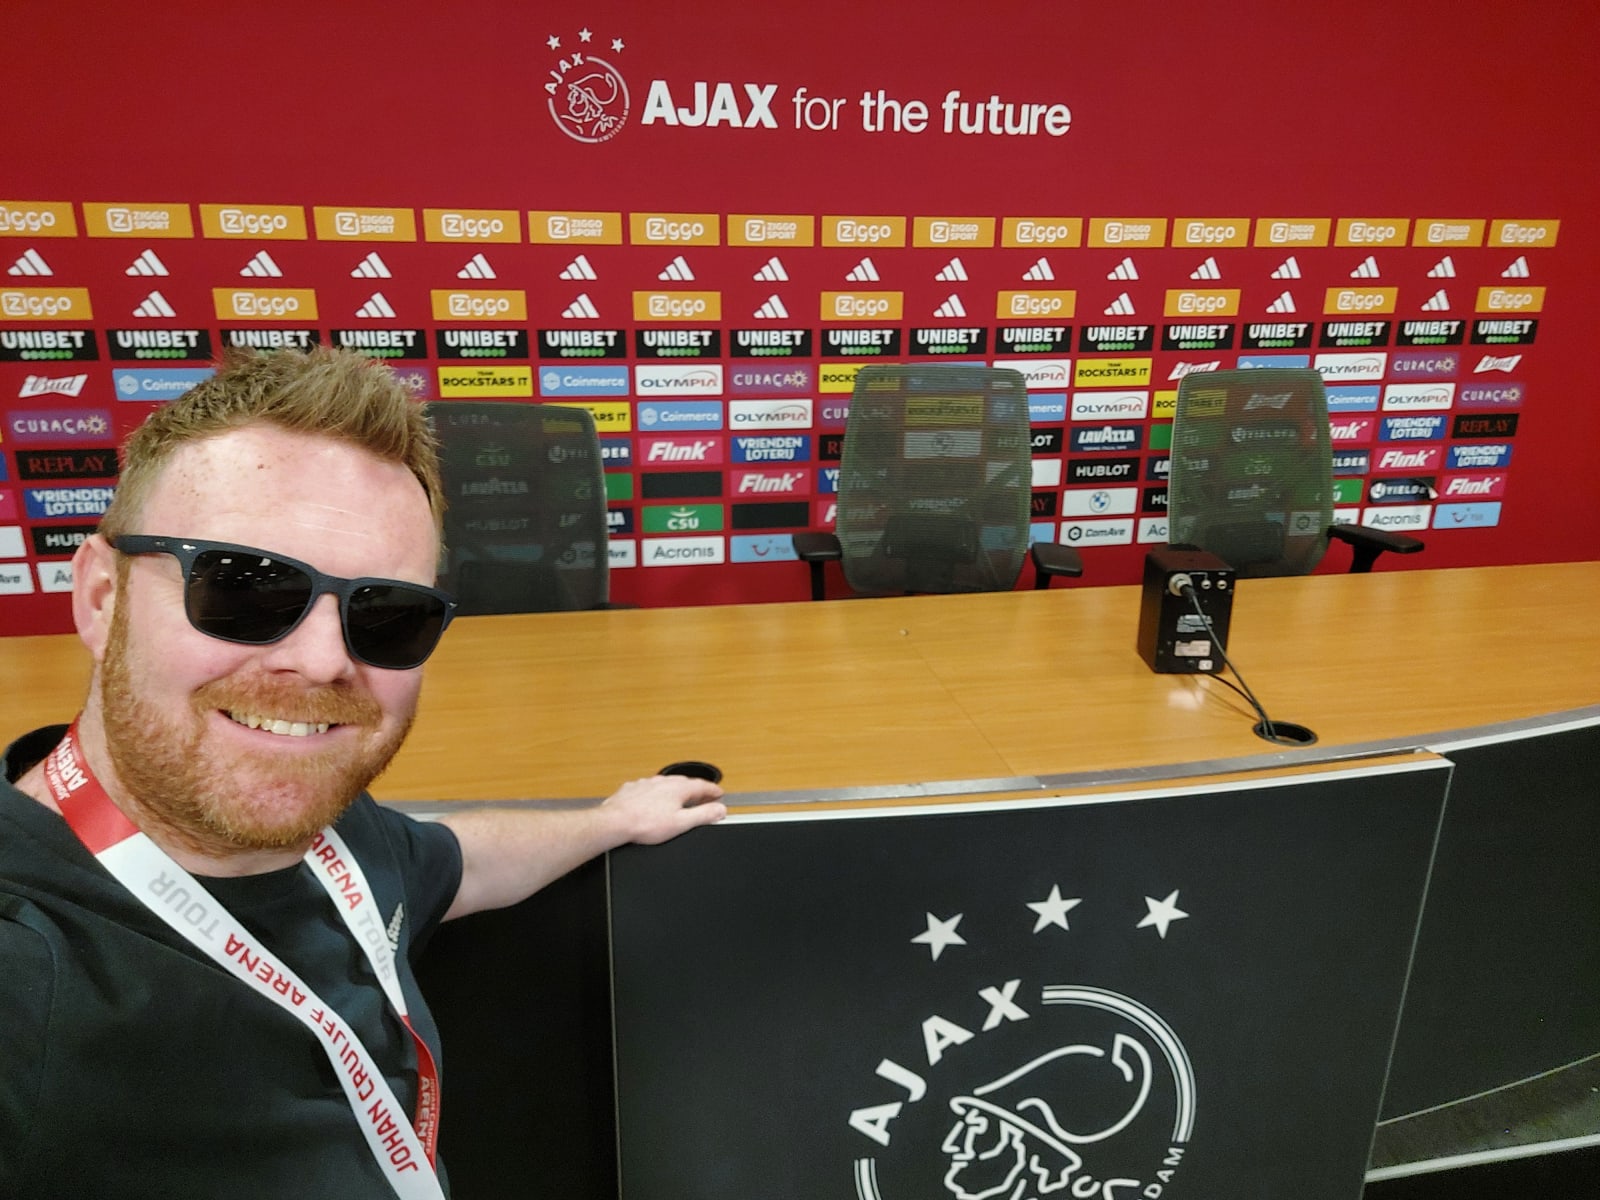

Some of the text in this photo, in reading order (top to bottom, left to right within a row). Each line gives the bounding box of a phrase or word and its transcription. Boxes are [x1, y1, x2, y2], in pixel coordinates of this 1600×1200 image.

[544, 52, 584, 95] AJAX
[641, 80, 1072, 136] AJAX for the future
[134, 211, 168, 220] ZIGGO
[133, 221, 170, 230] SPORT
[361, 225, 394, 234] SPORT
[571, 228, 602, 237] SPORT
[767, 231, 796, 239] SPORT
[1087, 326, 1148, 341] UNIBET
[1169, 326, 1228, 340] UNIBET
[1249, 324, 1307, 338] UNIBET
[1327, 322, 1385, 336] UNIBET
[1404, 322, 1460, 336] UNIBET
[1478, 321, 1532, 334] UNIBET
[0, 331, 85, 348] UNIBET
[117, 331, 199, 348] UNIBET
[230, 330, 310, 348] UNIBET
[340, 331, 416, 347] UNIBET
[444, 330, 518, 346] UNIBET
[546, 330, 618, 346] UNIBET
[643, 331, 712, 346] UNIBET
[737, 330, 804, 346] UNIBET
[829, 330, 894, 345] UNIBET
[917, 329, 980, 344] UNIBET
[1003, 328, 1065, 342] UNIBET
[1078, 368, 1148, 377] ROCKSTARS IT
[1318, 364, 1380, 374] OLYMPIA
[443, 378, 528, 386] ROCKSTARS IT
[563, 376, 625, 388] Coinmerce
[641, 376, 718, 388] OLYMPIA
[734, 370, 808, 388] CURAÇAO
[822, 374, 857, 382] ROCKS
[1024, 372, 1065, 380] MPIA
[29, 376, 76, 392] Bud
[142, 379, 196, 390] Coinme
[1327, 395, 1376, 404] Coinmerce
[1387, 394, 1449, 404] OLYMPIA
[1030, 404, 1062, 412] merce
[1076, 404, 1142, 413] OLYMPIA
[617, 413, 628, 421] IT
[660, 412, 720, 422] Coinmerce
[734, 410, 807, 422] OLYMPIA
[1387, 417, 1440, 428] VRIENDEN
[14, 415, 107, 434] CURAÇAO
[1330, 422, 1368, 439] ink
[1460, 420, 1510, 432] REPLAY
[1078, 426, 1134, 444] LAVAZZA
[1390, 428, 1432, 439] LOTERIJ
[737, 436, 802, 448] VRIENDEN
[648, 441, 715, 461] Flink
[746, 448, 794, 460] LOTERIJ
[1454, 446, 1506, 456] VRIENDEN
[28, 456, 106, 472] REPLAY
[1332, 457, 1368, 467] ELDER
[1379, 450, 1436, 468] Flink
[1458, 456, 1498, 466] LOTERIJ
[1076, 465, 1130, 476] HUBLOT
[738, 472, 804, 492] Flink
[1446, 477, 1500, 494] Flink
[32, 488, 114, 502] VRIENDEN
[1386, 484, 1425, 494] YIELDE
[45, 502, 106, 516] LOTERIJ
[667, 518, 699, 530] CSU
[1371, 514, 1421, 524] Acronis
[1085, 528, 1126, 538] ComAve
[46, 533, 86, 547] HUB
[653, 546, 714, 559] Acronis
[312, 832, 391, 980] ARENA TOUR
[148, 870, 418, 1172] JOHAN CRUIJFF ARENA TOUR
[848, 978, 1030, 1147] AJAX
